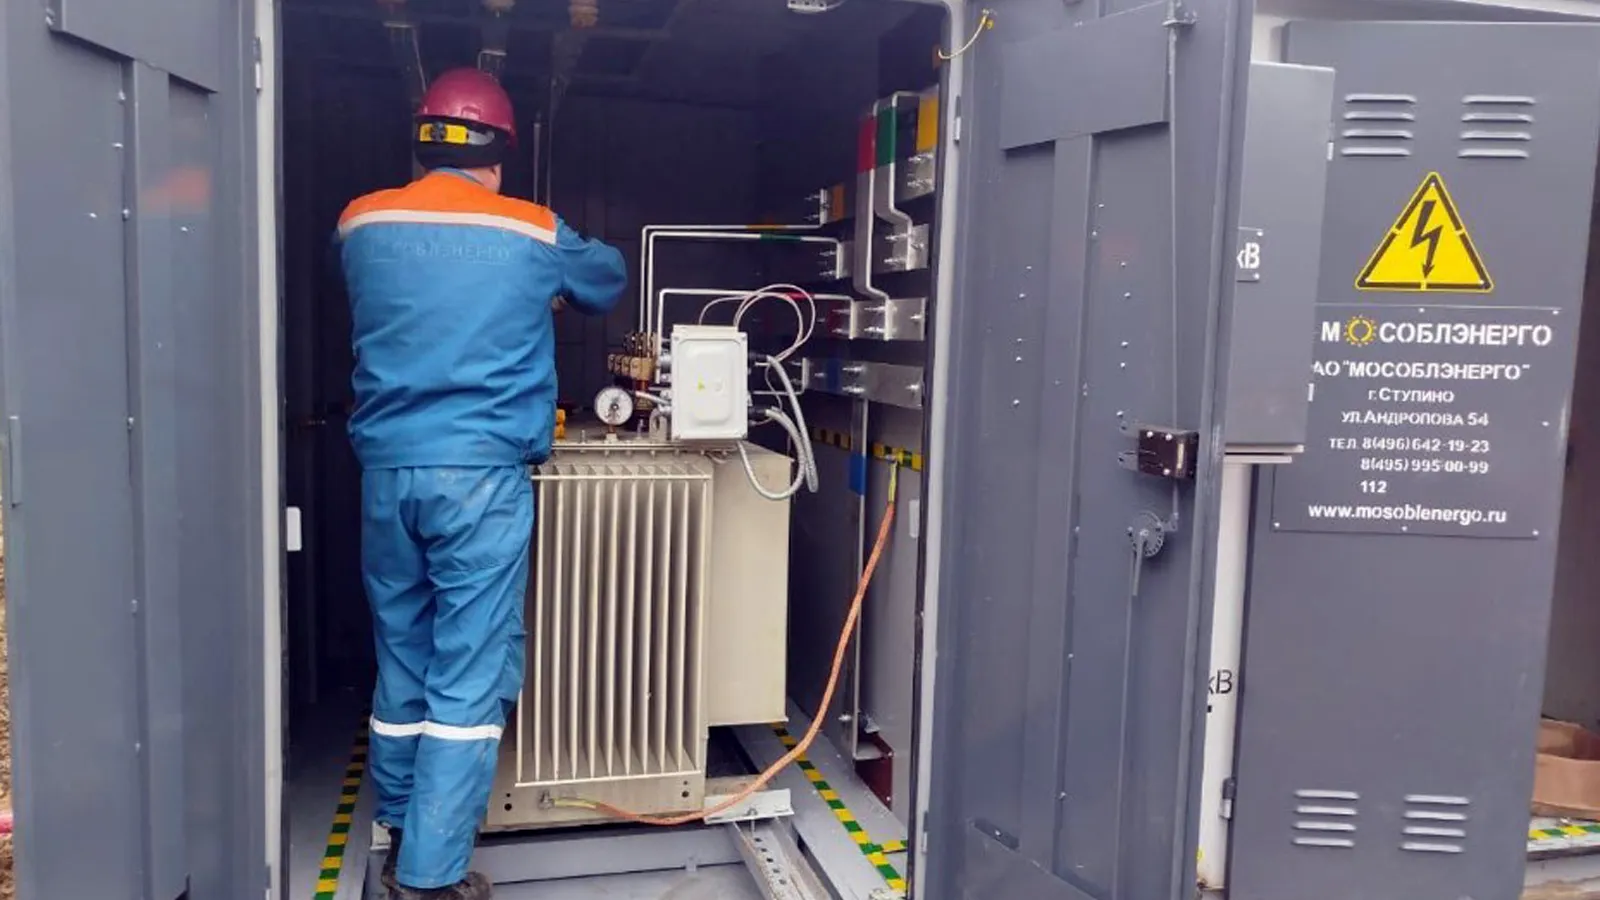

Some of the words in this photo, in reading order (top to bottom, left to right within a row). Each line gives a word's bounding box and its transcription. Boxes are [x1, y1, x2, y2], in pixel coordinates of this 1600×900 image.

[1343, 360, 1530, 379] "МОСОБЛЭНЕРГО"
[1467, 412, 1489, 426] 54
[1360, 480, 1387, 493] 112
[1308, 504, 1507, 525] www.mosoblenergo.ru
